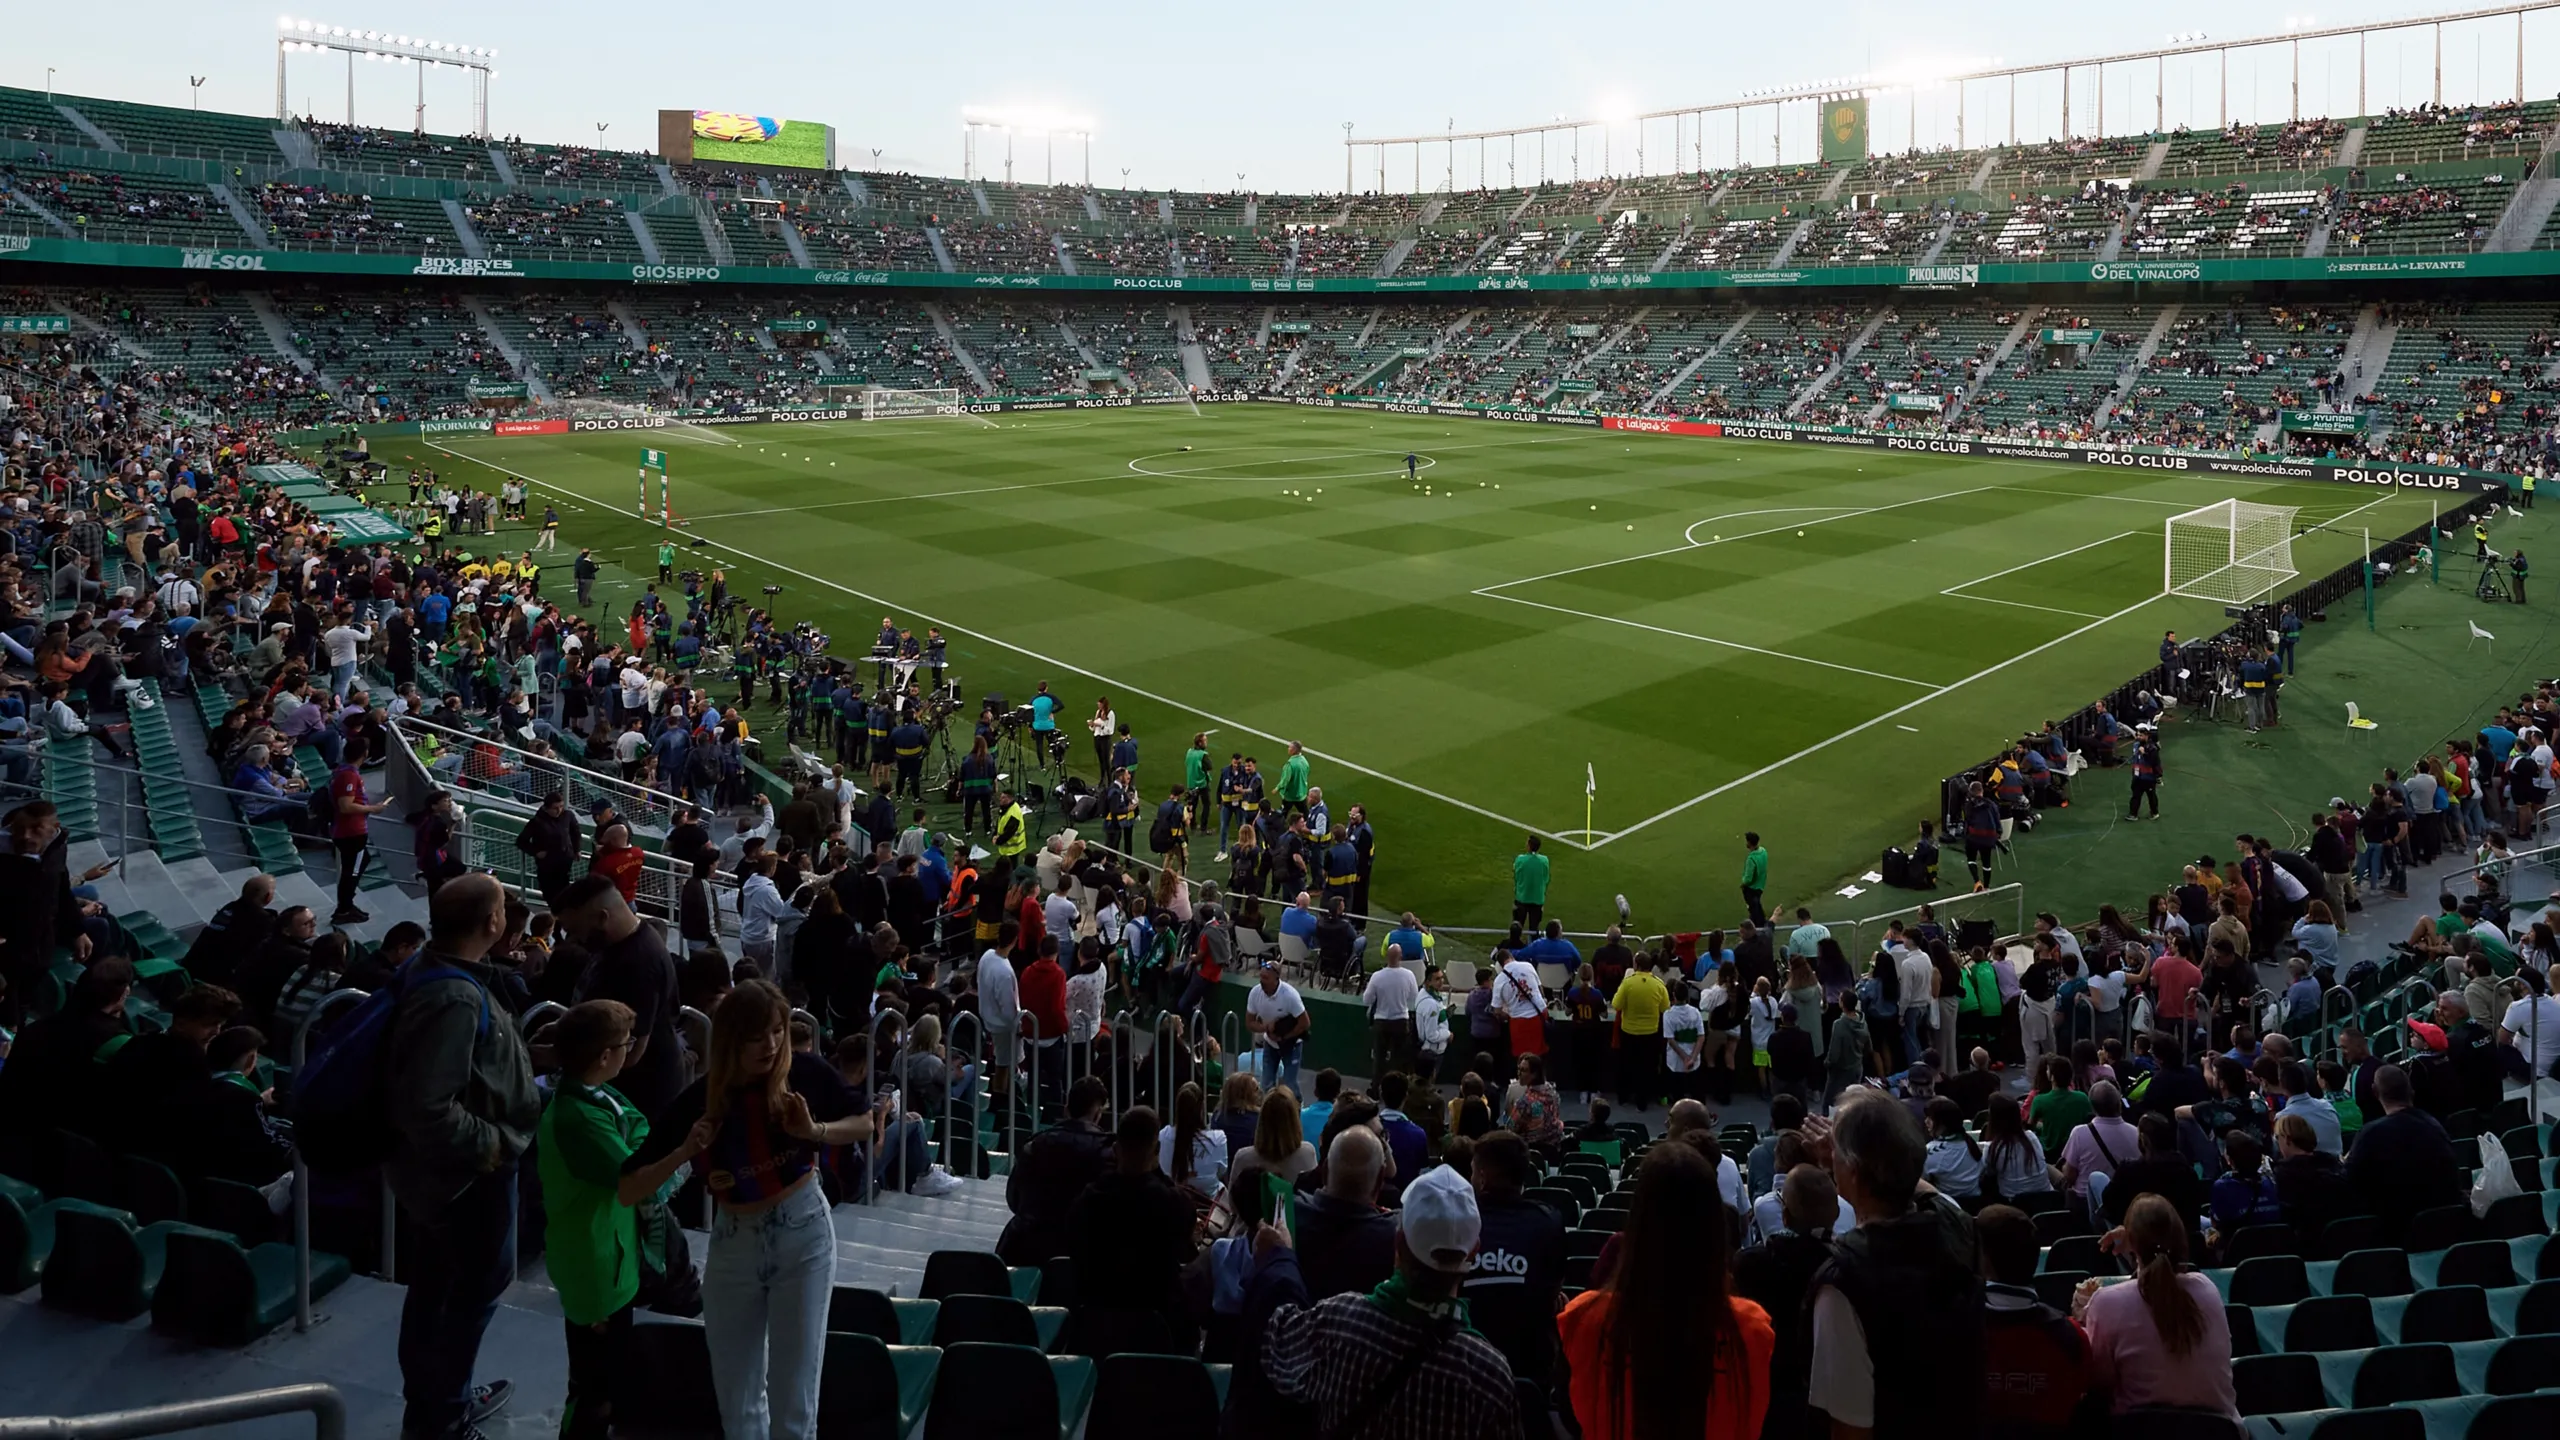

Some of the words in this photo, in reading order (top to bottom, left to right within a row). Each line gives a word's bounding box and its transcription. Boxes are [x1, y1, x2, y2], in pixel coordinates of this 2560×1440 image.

[182, 253, 267, 271] MI-SOL
[421, 257, 457, 267] BOX
[461, 258, 513, 269] REYES
[2339, 262, 2399, 271] ESTRELLA
[2409, 261, 2466, 270] LEVANTE
[632, 265, 720, 280] GIOSEPPO
[1909, 267, 1961, 281] PIKOLINOS
[2109, 270, 2134, 280] DEL
[2137, 265, 2200, 279] VINALOPÓ
[1113, 279, 1147, 288] POLO
[1148, 279, 1182, 288] CLUB
[1076, 399, 1104, 408] POLO
[1105, 398, 1132, 407] CLUB
[1197, 394, 1220, 402] POLO
[1221, 393, 1249, 401] CLUB
[1296, 397, 1315, 405] POLO
[1315, 399, 1335, 407] CLUB
[937, 406, 968, 414] POLO
[970, 403, 1001, 413] CLUB
[1385, 403, 1407, 412] POLO
[1407, 405, 1430, 414] CLUB
[771, 412, 809, 422] POLO
[811, 410, 848, 420] CLUB
[1487, 410, 1511, 420] POLO
[1512, 412, 1539, 422] CLUB
[574, 419, 619, 431] POLO
[622, 417, 666, 429] CLUB
[1626, 420, 1652, 431] LaLiga
[1724, 426, 1757, 438] POLO
[1759, 429, 1793, 441] CLUB
[1807, 433, 1875, 446] www.poloclub.com
[1887, 437, 1927, 451] POLO
[1929, 440, 1970, 454] CLUB
[1986, 445, 2070, 460] www.poloclub.com
[2086, 450, 2135, 466] POLO
[2138, 454, 2189, 470] CLUB
[2210, 461, 2312, 478] www.poloclub.com
[2333, 468, 2392, 485] POLO
[2397, 472, 2460, 490] CLUB
[1576, 1003, 1593, 1020] 10
